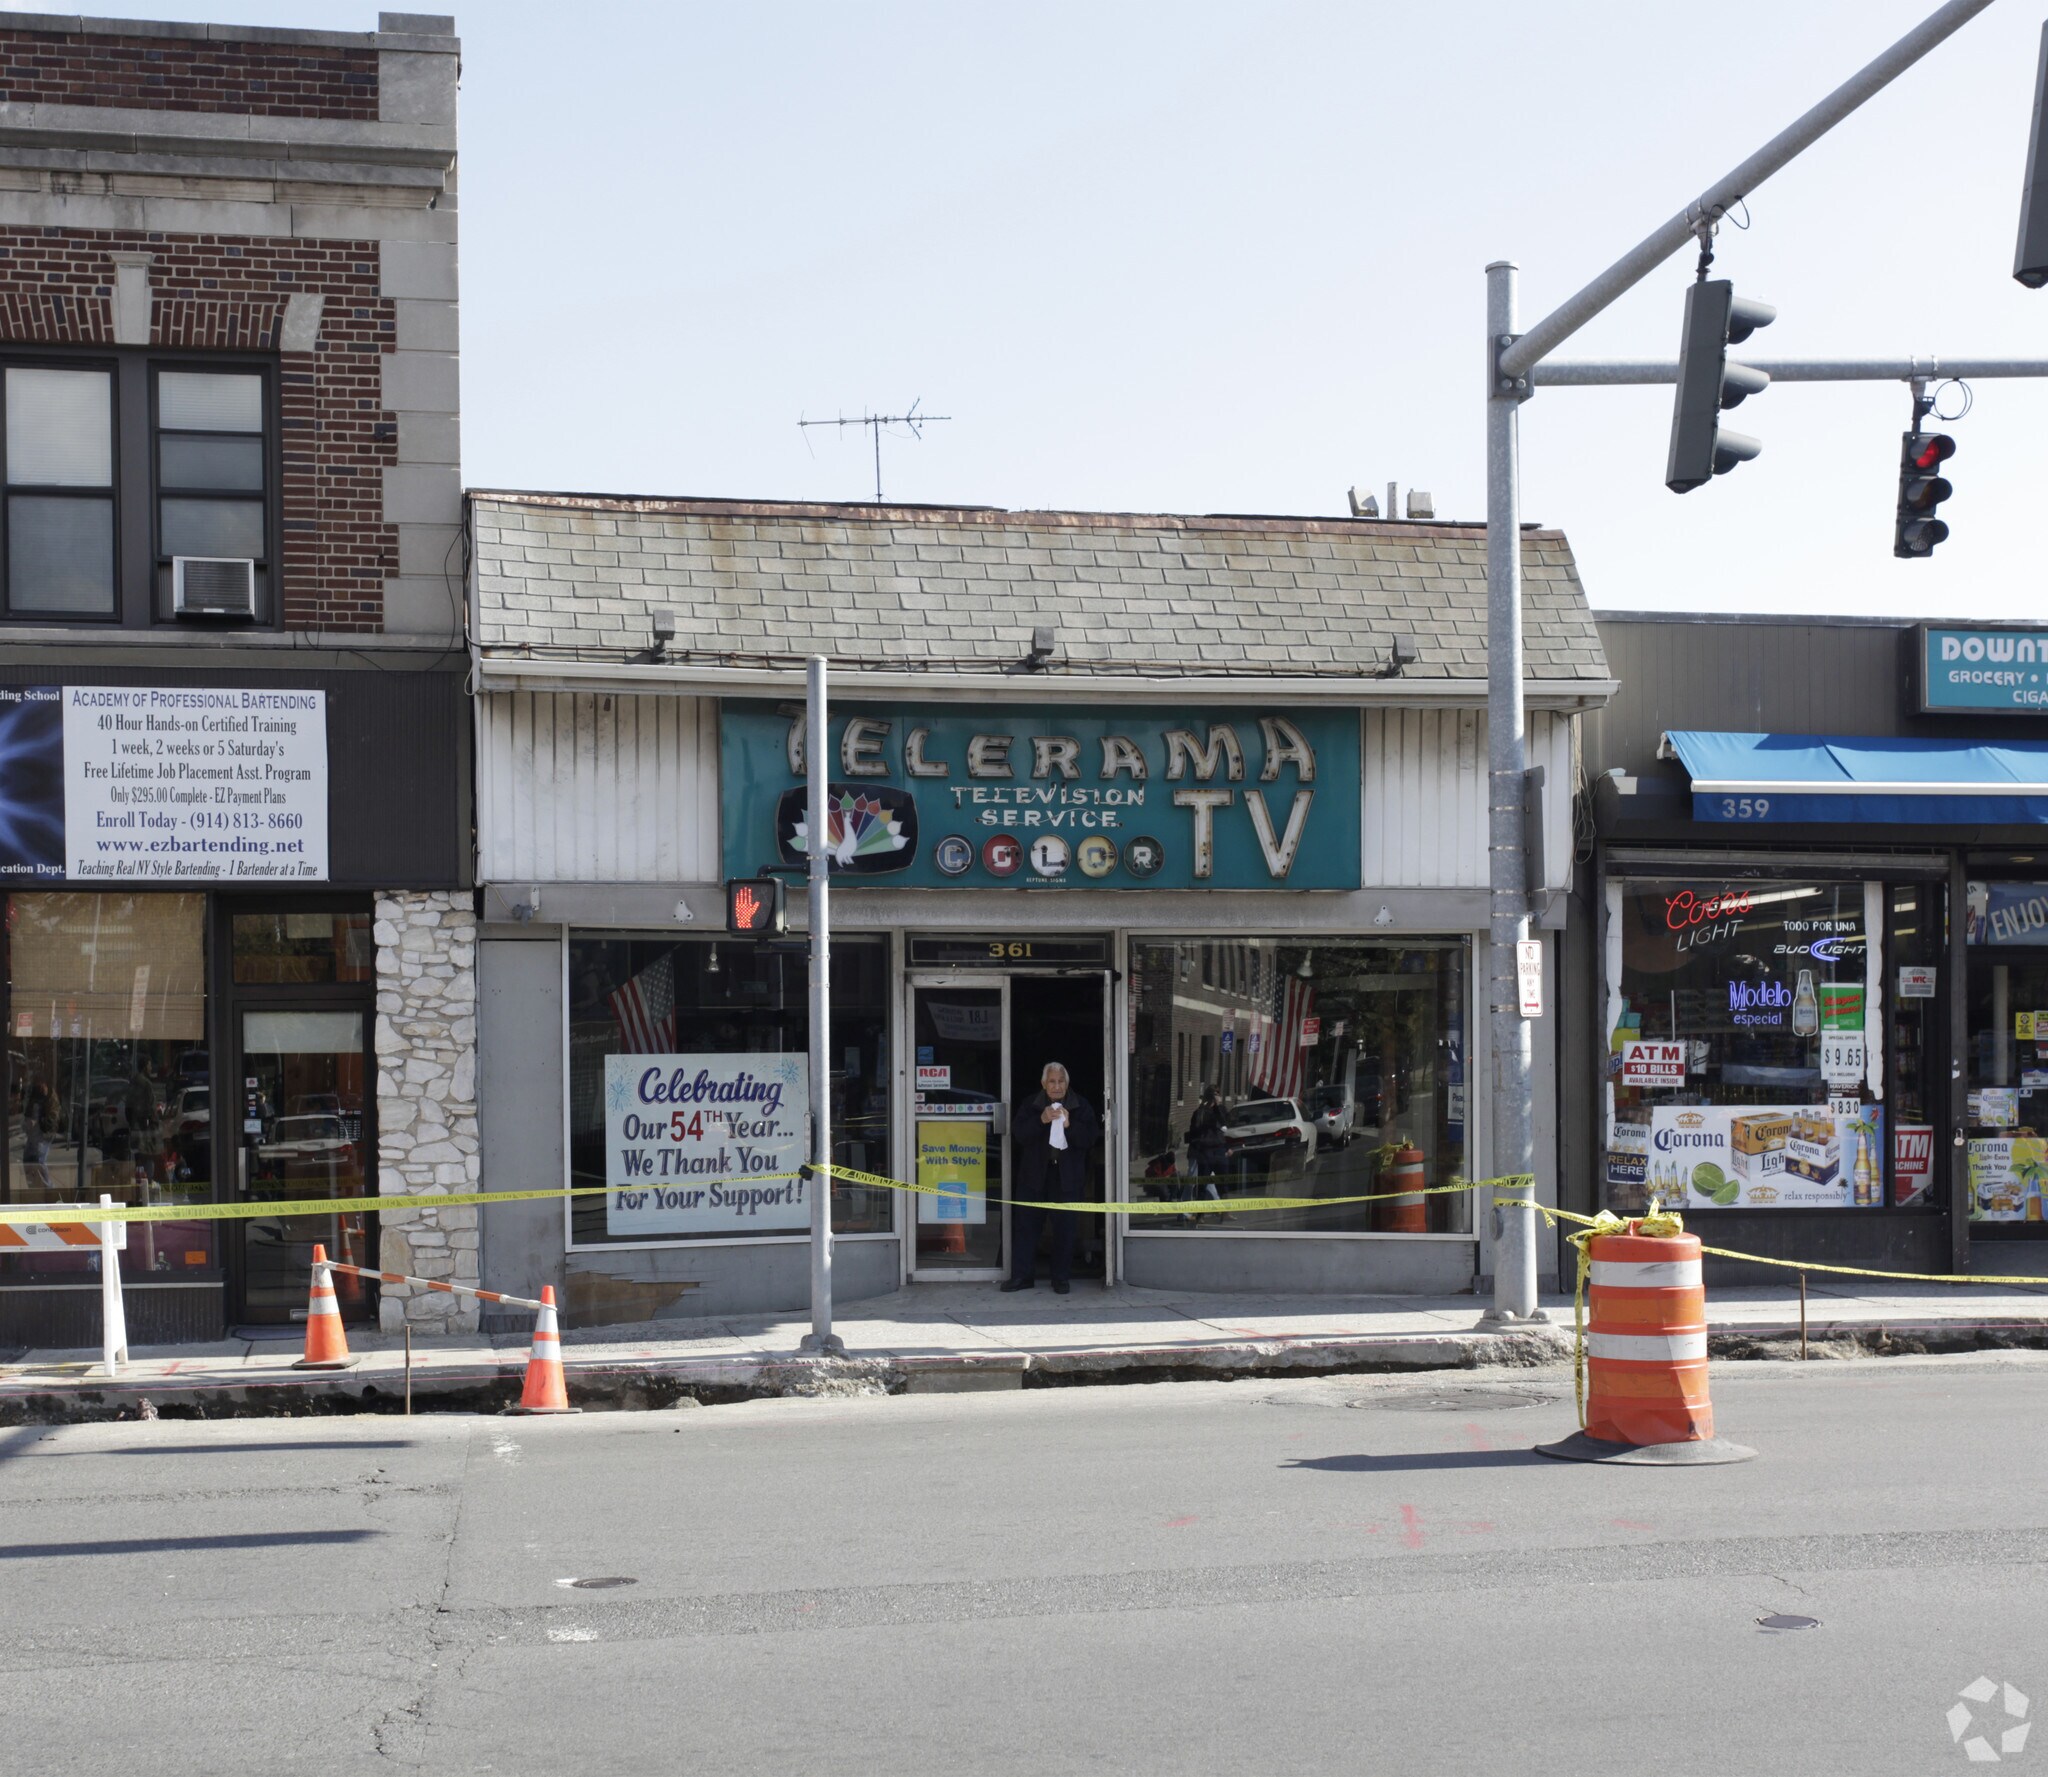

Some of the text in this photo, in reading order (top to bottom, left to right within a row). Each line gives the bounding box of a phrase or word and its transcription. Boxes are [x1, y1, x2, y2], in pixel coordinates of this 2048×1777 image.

[1948, 670, 2025, 687] GROCERY
[24, 690, 60, 701] School
[72, 690, 317, 710] ACADEMY OF PROFESSIONAL BARTENDING
[97, 714, 297, 736] 40 Hour Hands-on Certified Training
[111, 739, 285, 759] 1 week, 2 weeks or 5 Saturday's
[777, 703, 1317, 781] TELERAMA
[84, 762, 311, 783] Free Lifetime Job Placement Asst. Program
[110, 787, 287, 807] Only $295.00 Complete EZ Payment Plans
[950, 784, 1145, 806] TELEVISION
[981, 808, 1118, 828] SERVICE
[1721, 798, 1770, 820] 359
[96, 811, 135, 828] Enroll
[138, 811, 178, 831] Today
[189, 812, 229, 831] (914)
[268, 813, 303, 830] 8660
[1173, 788, 1316, 879] TV
[96, 836, 304, 855] www.ezbartending.net
[36, 863, 66, 876] Dept.
[77, 859, 115, 877] Teaching
[116, 859, 136, 876] Real
[136, 860, 151, 876] NY
[151, 860, 172, 878] Style
[174, 860, 221, 878] Bartending
[235, 861, 278, 877] Bartender
[278, 863, 288, 877] at
[289, 866, 296, 877] a
[297, 861, 318, 877] Time
[1665, 889, 1754, 929] Coors
[1783, 920, 1857, 932] TODO POR UNA
[1676, 919, 1745, 952] LIGHT
[988, 942, 1033, 958] 361
[1525, 946, 1534, 960] NO
[1773, 944, 1867, 955] BUD LIGHT
[1520, 962, 1541, 977] PARKING
[1729, 980, 1792, 1012] Modelo
[1733, 1012, 1783, 1028] especial
[1629, 1045, 1680, 1061] ATM
[919, 1067, 948, 1078] RCA
[1630, 1064, 1678, 1075] $10 BILLS
[1660, 1077, 1679, 1085] INSIDE
[637, 1066, 786, 1117] Celebrating
[622, 1112, 668, 1141] Our
[1613, 1126, 1647, 1140] Corona
[1755, 1123, 1792, 1141] Coron
[921, 1144, 984, 1154] Save Money.
[1654, 1127, 1725, 1154] Corona
[1789, 1140, 1821, 1157] Corona
[621, 1146, 779, 1177] We Thank You
[926, 1156, 981, 1166] With Style.
[1608, 1155, 1647, 1166] RELAX
[1761, 1152, 1785, 1173] Ligh
[1972, 1163, 2007, 1171] Thank You
[1610, 1164, 1644, 1176] HERE
[614, 1178, 805, 1216] For Your Support!
[1784, 1189, 1848, 1204] relax responsibly
[38, 1226, 72, 1234] conEdison
